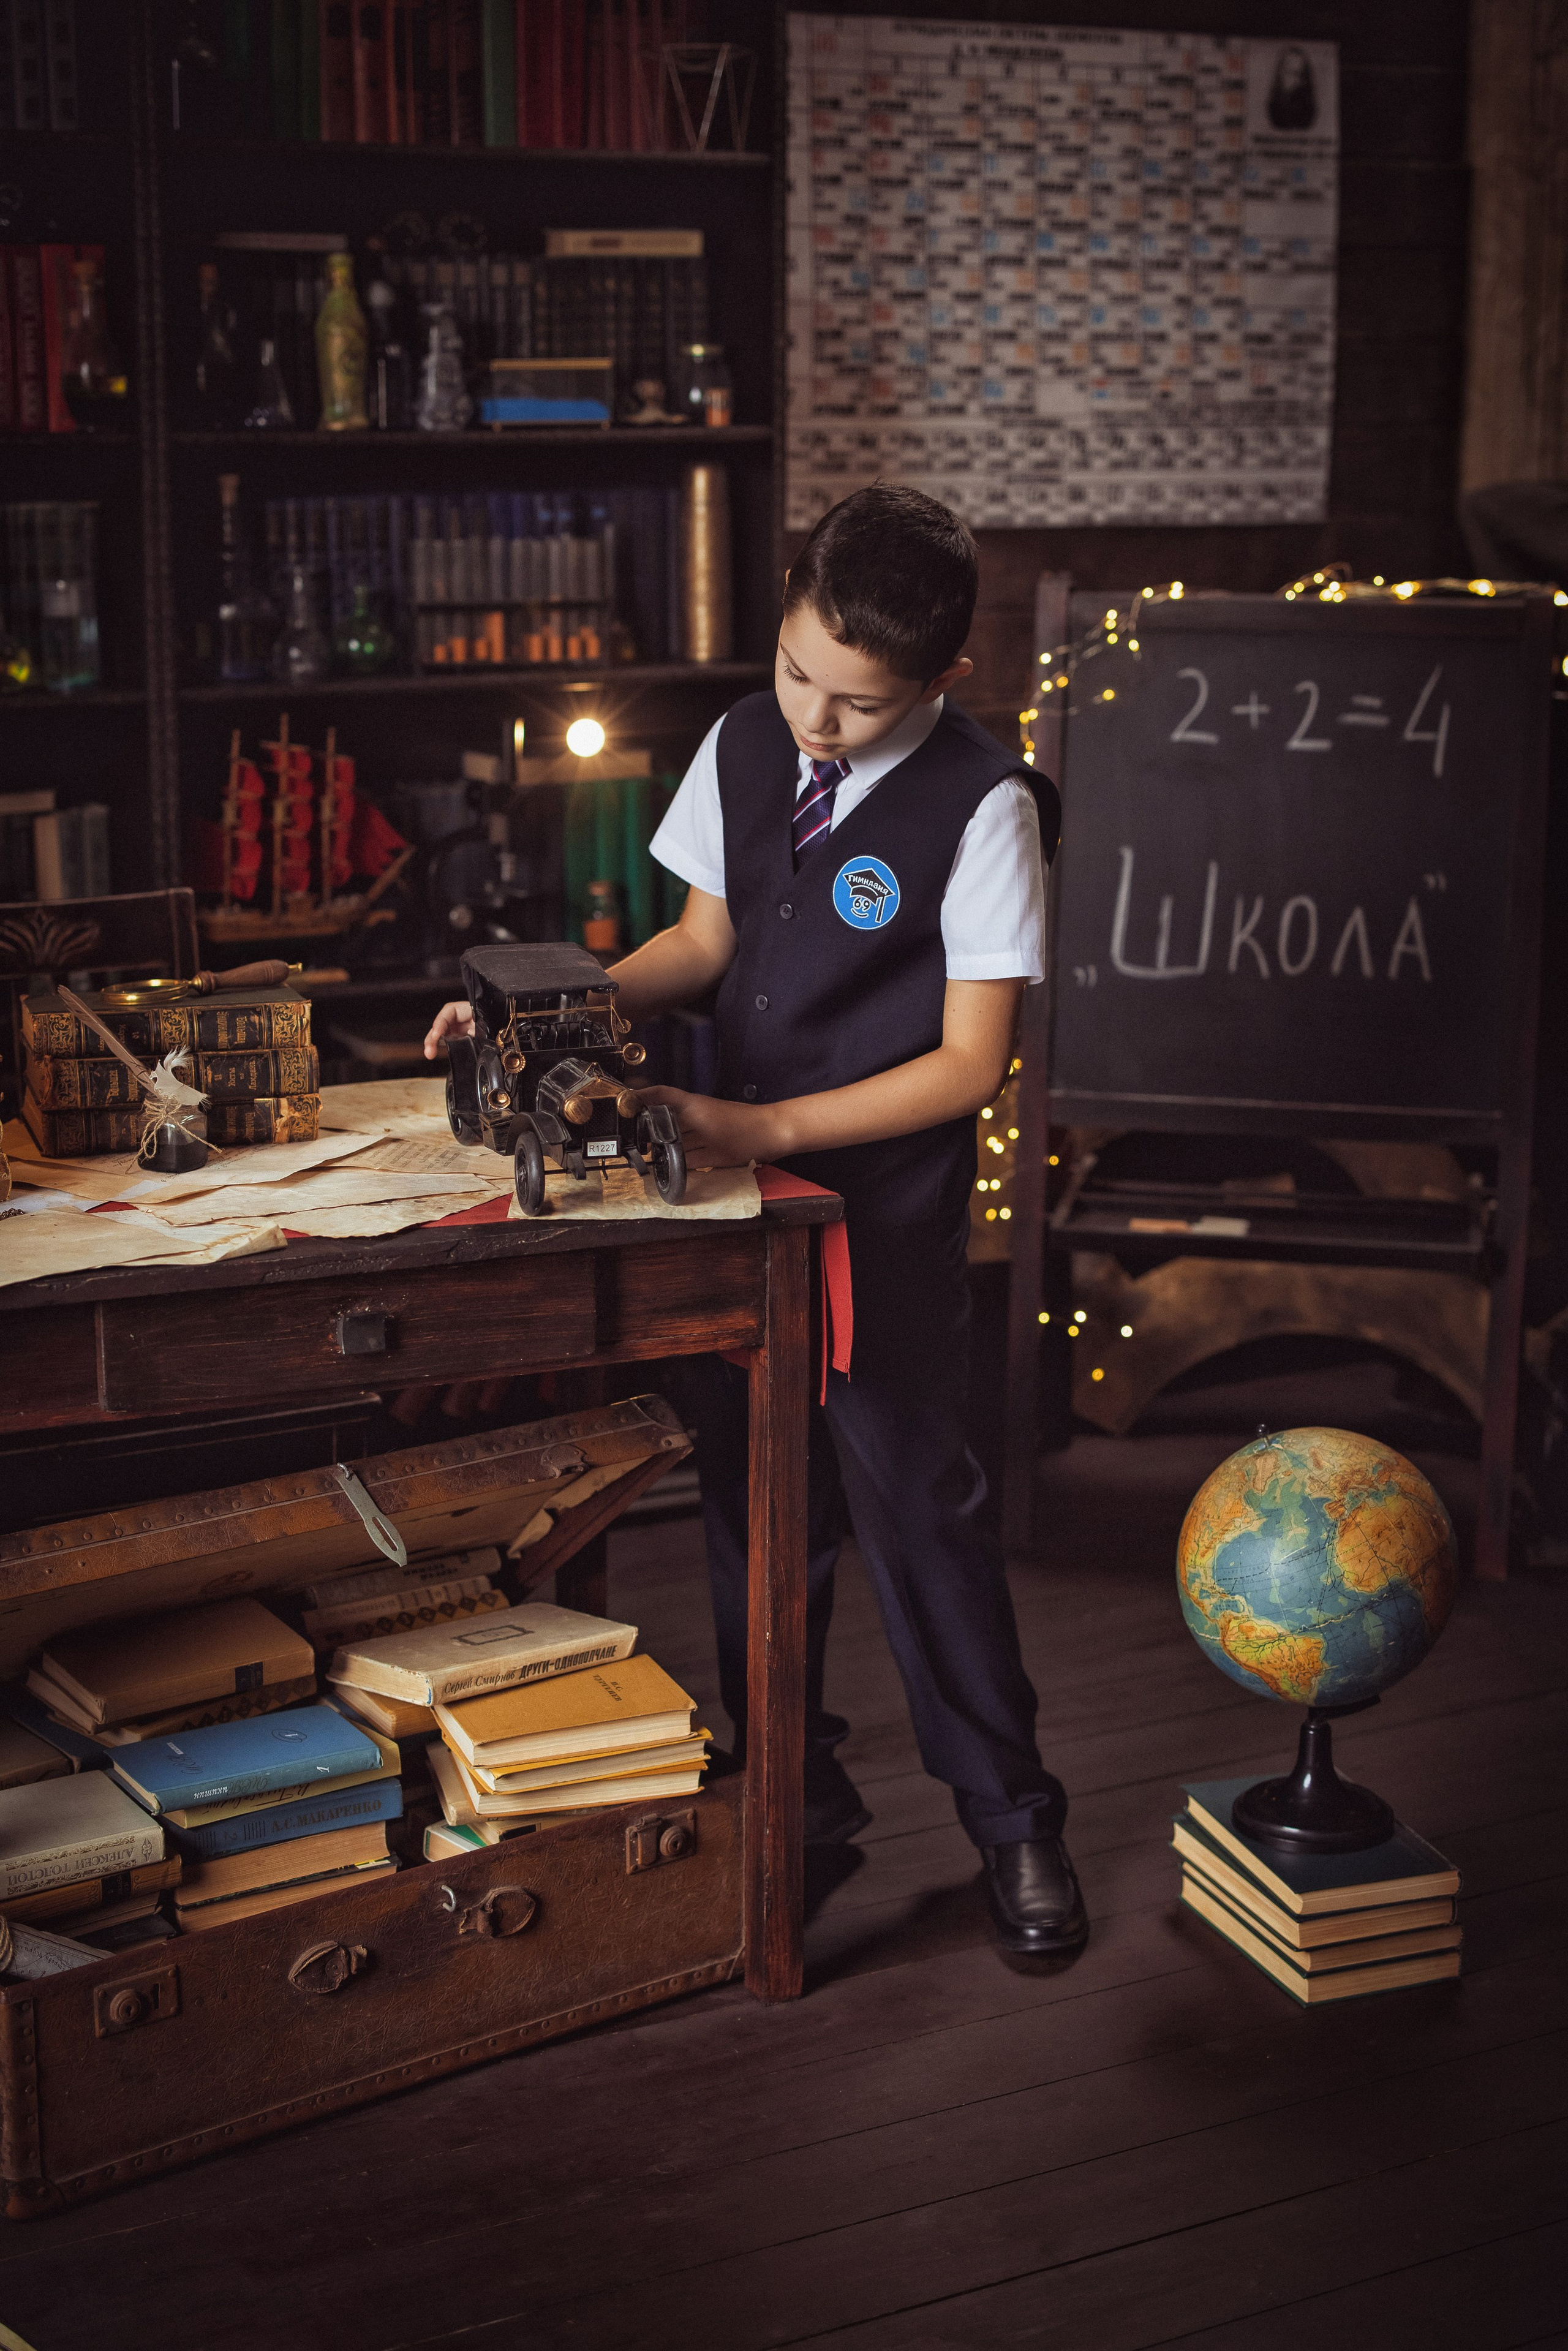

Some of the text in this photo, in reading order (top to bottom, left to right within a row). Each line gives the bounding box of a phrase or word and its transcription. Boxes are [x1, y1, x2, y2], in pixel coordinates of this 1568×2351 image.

[848, 875, 889, 896] ГИМНАЗИЯ
[853, 897, 871, 911] 69
[589, 1144, 616, 1153] R1227
[444, 1645, 618, 1694] Сергей Смирнов ДРУГИ-ОДНОПОЛЧАНЕ
[8, 1846, 135, 1885] АЛЕКСЕЙ ТОЛСТОЙ
[45, 1955, 66, 1972] строва
